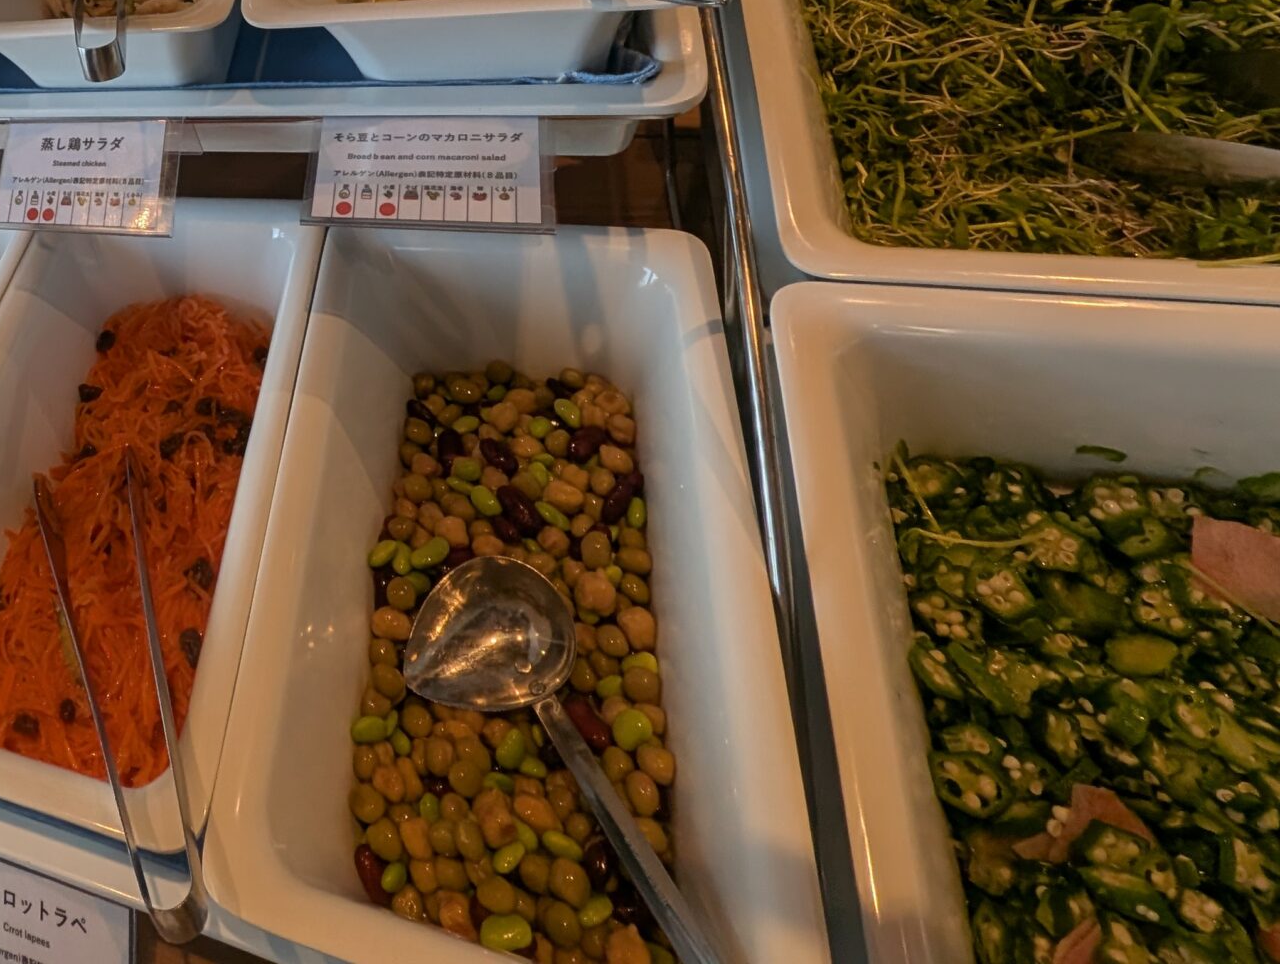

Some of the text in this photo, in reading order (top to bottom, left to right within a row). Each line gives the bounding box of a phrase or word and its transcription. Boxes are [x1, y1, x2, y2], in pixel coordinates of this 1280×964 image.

[333, 131, 524, 143] そら豆とコーンのマカロニサラダ
[40, 136, 125, 151] 蒸し鶏サラダ
[397, 153, 414, 161] and
[437, 153, 479, 161] macaroni
